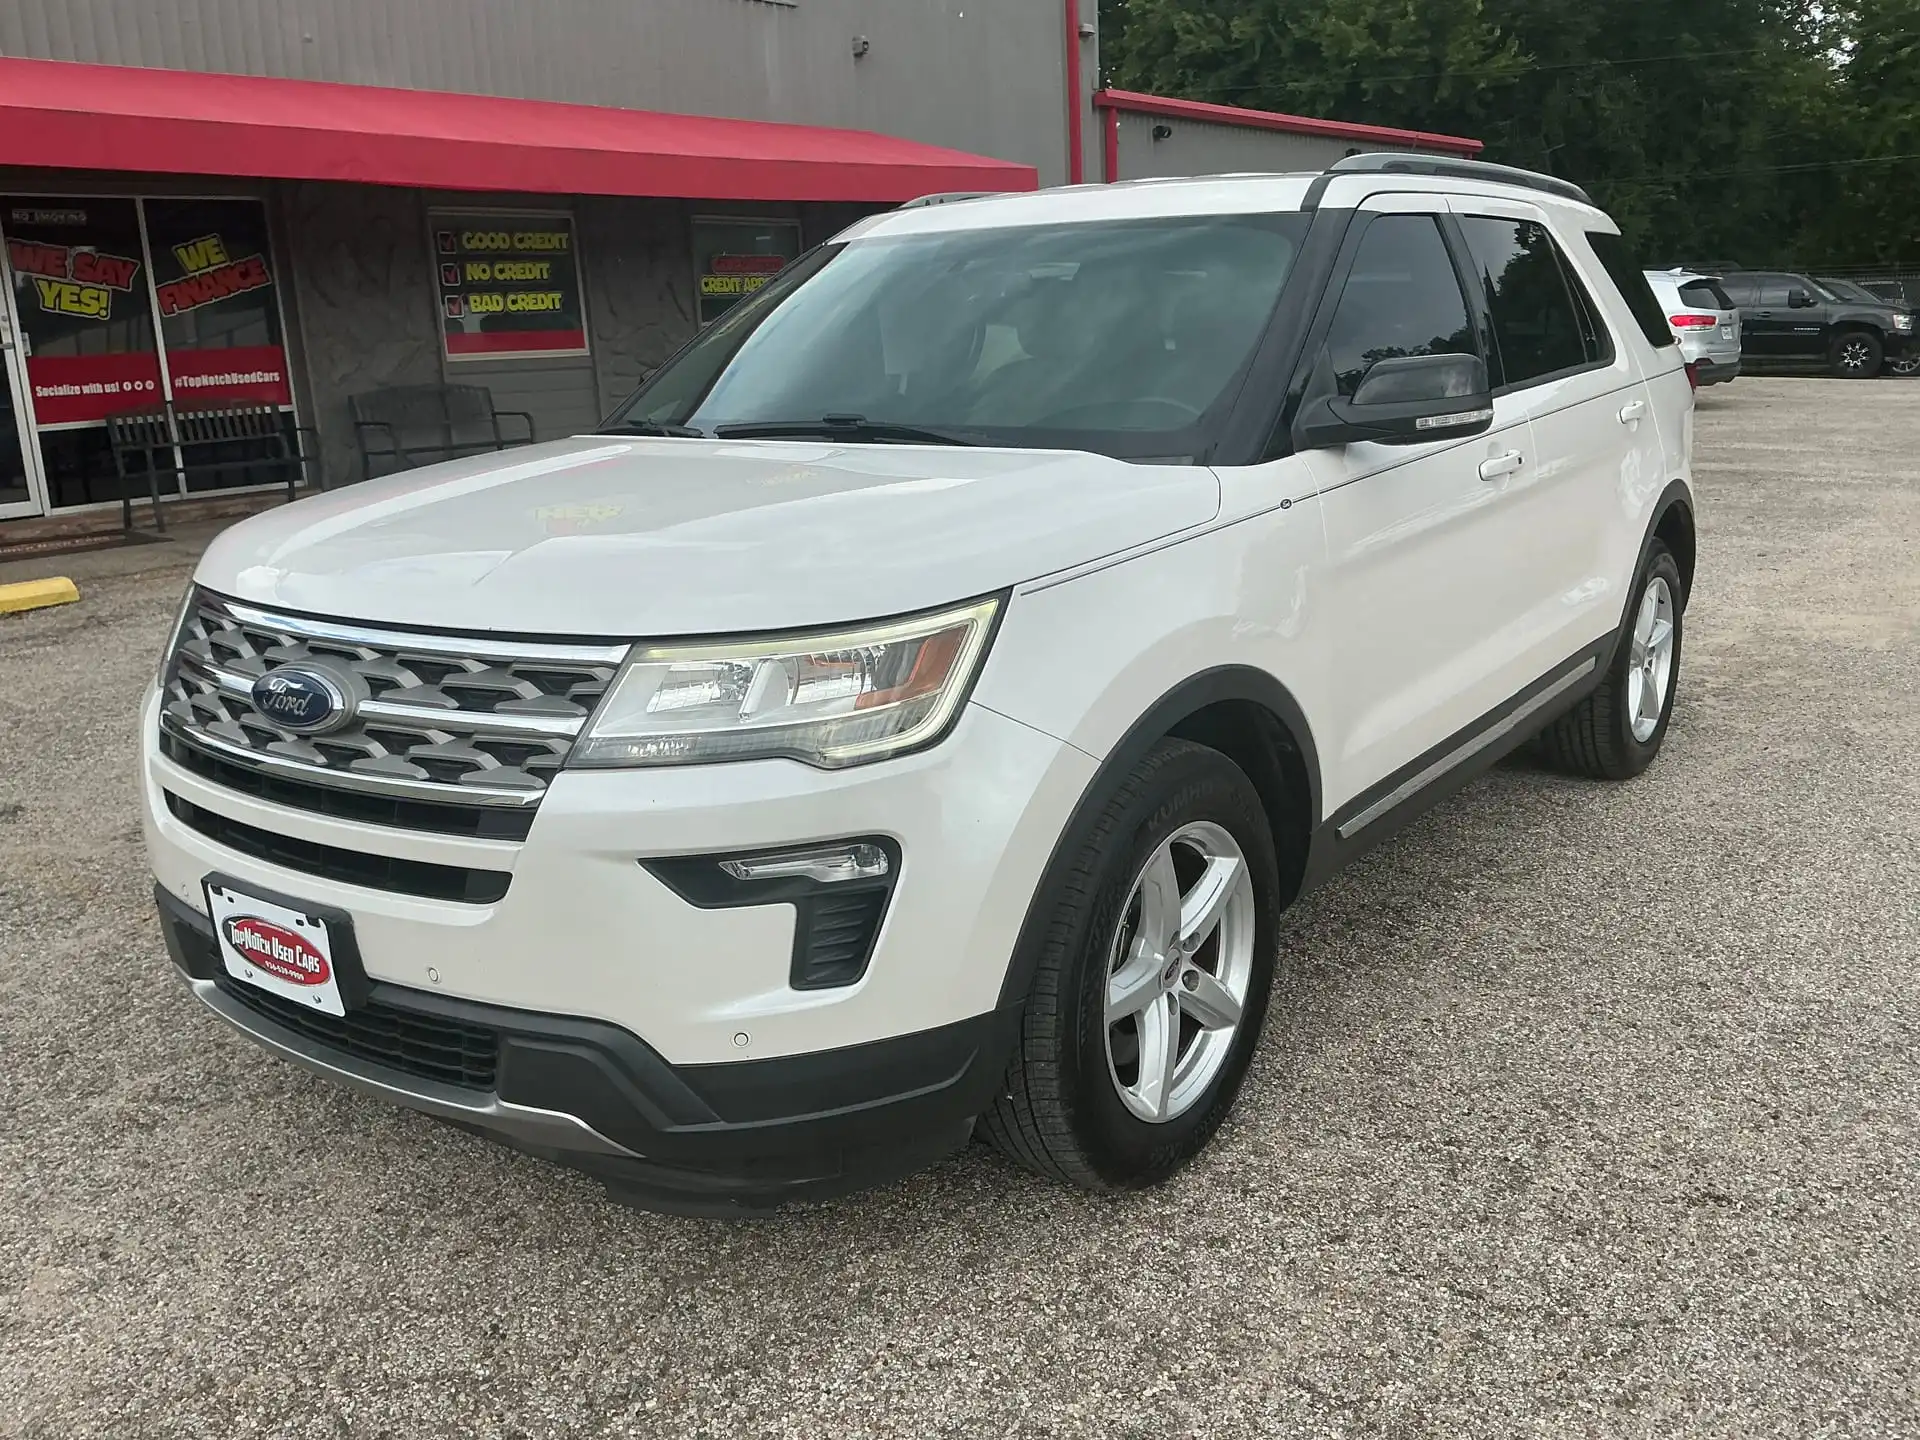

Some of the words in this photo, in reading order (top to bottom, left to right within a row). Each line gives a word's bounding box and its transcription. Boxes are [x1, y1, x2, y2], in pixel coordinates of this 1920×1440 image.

[462, 232, 510, 250] GOOD
[513, 233, 568, 250] CREDIT
[8, 240, 68, 278] WE
[73, 251, 136, 288] SAY
[176, 238, 227, 271] WE
[466, 263, 491, 281] NO
[494, 262, 550, 280] CREDIT
[36, 279, 109, 317] YES!
[157, 256, 270, 315] FINANCE
[702, 277, 740, 293] CREDIT
[744, 277, 771, 293] APP
[469, 295, 504, 312] BAD
[506, 293, 561, 311] CREDIT
[35, 384, 81, 397] Socialize
[82, 382, 103, 394] with
[105, 381, 120, 393] us!
[175, 371, 280, 388] #TopNotchUsedCars
[263, 677, 315, 717] Ford
[271, 936, 294, 964] USED
[295, 944, 320, 973] CARS
